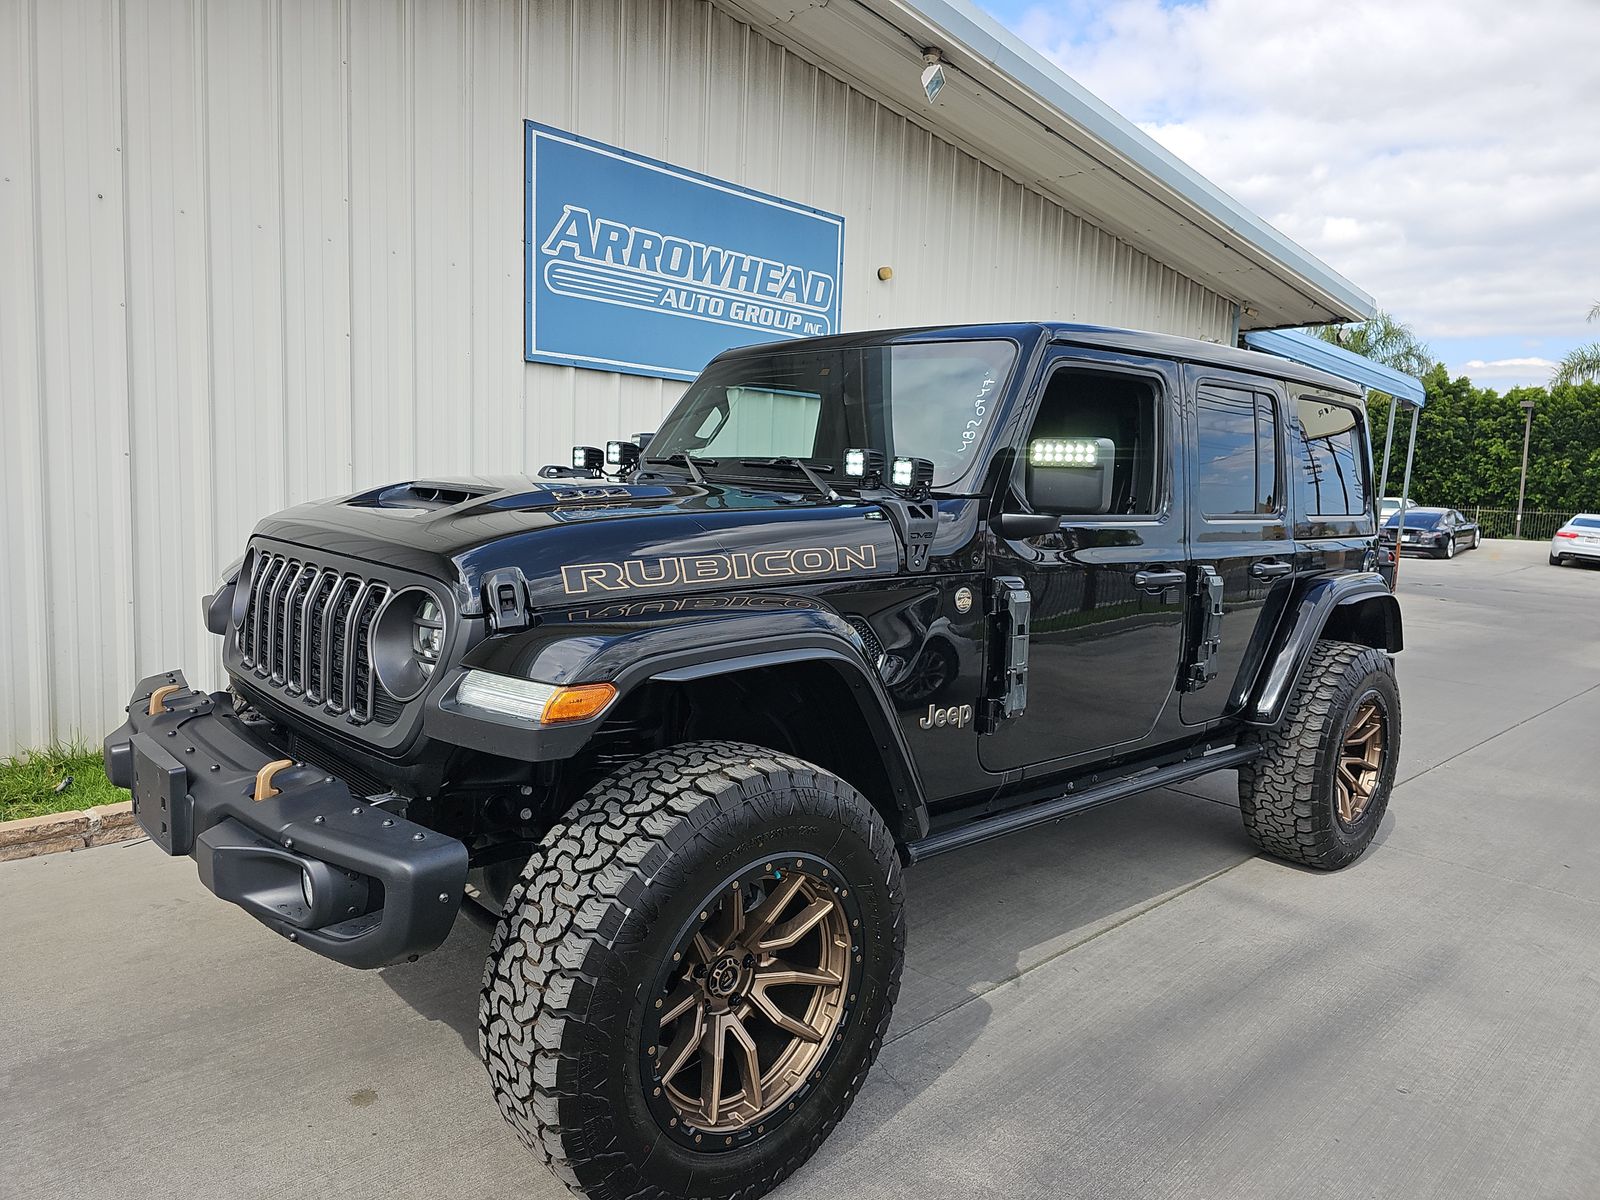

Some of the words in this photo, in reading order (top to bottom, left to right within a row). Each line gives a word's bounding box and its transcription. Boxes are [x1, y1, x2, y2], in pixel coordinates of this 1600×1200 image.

[541, 204, 834, 312] ARROWHEAD
[659, 288, 724, 316] AUTO
[729, 302, 802, 330] GROUP
[560, 545, 877, 594] RUBICON
[919, 703, 973, 729] Jeep
